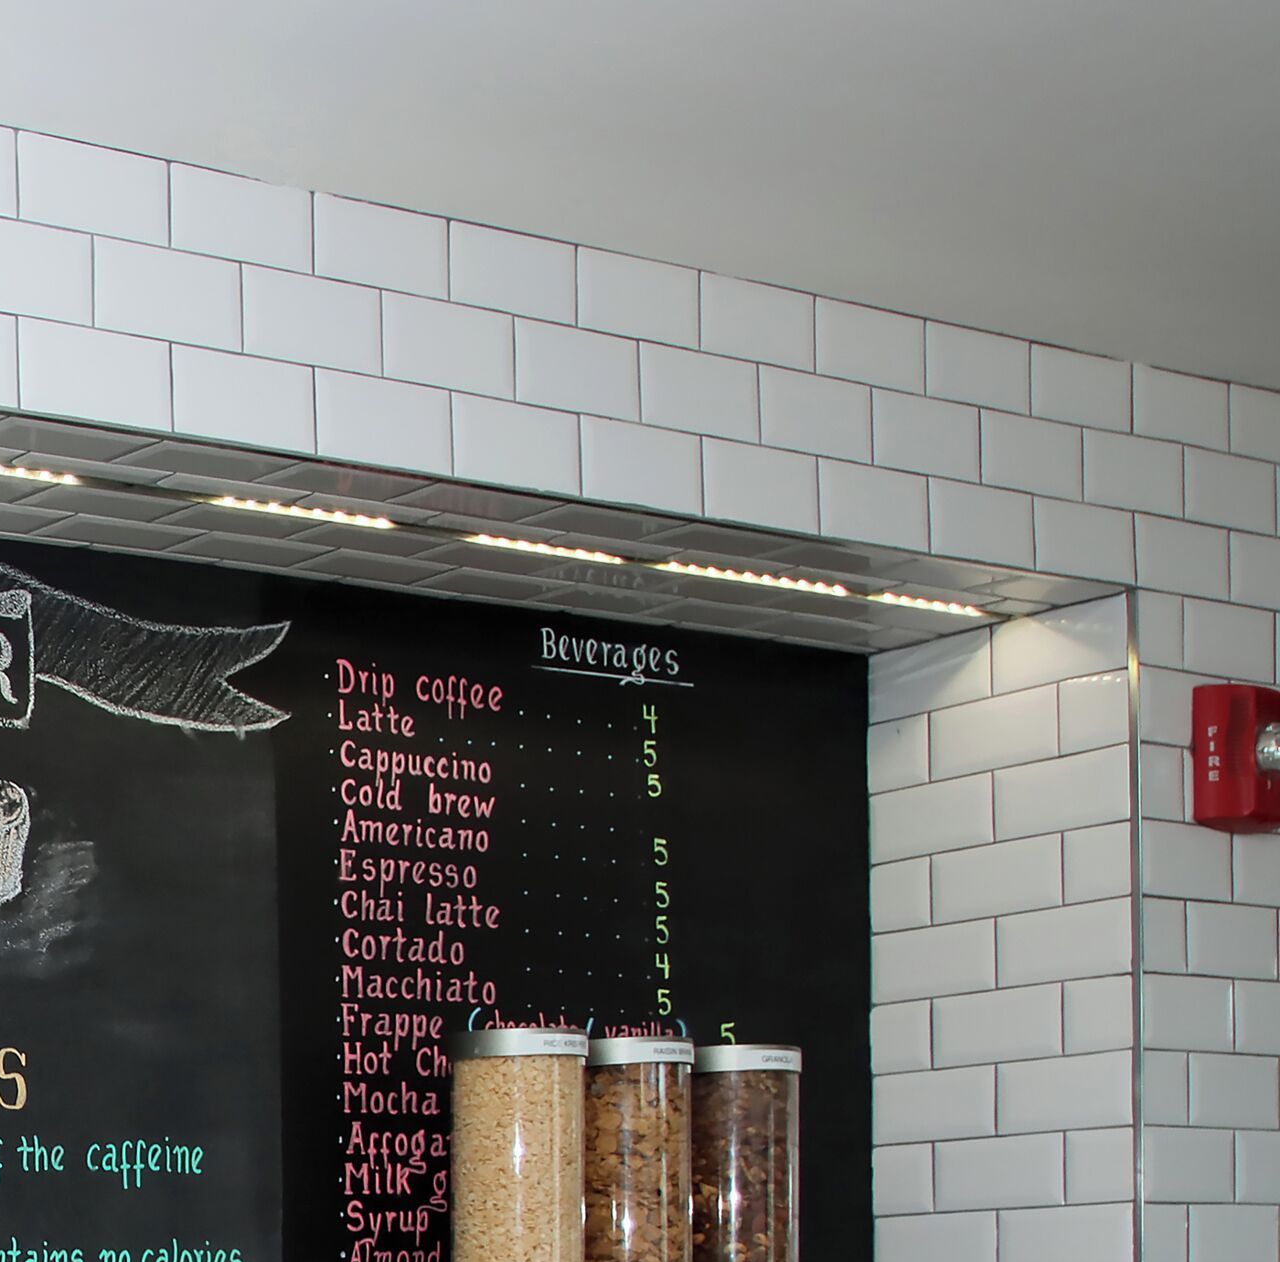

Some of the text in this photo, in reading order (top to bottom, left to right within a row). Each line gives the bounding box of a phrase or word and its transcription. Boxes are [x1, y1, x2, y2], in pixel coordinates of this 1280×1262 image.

[540, 627, 681, 686] Beverages
[336, 658, 658, 735] Drip coffee 4
[338, 700, 658, 768] Latte 5
[1207, 724, 1221, 782] FIRE
[340, 741, 662, 798] Cappuccino 5
[341, 779, 495, 819] Cold brew
[341, 809, 669, 867] Americano 5
[339, 849, 670, 909] Espresso 5
[341, 891, 669, 945] Chai latte 5
[342, 928, 670, 981] Cortado 4
[341, 964, 672, 1017] Macchiato 5
[341, 1003, 443, 1051] Frappe
[342, 1041, 392, 1077] Hot
[343, 1081, 440, 1116] Mocha
[16, 1134, 65, 1172] the
[86, 1136, 204, 1189] caffeine
[344, 1161, 412, 1196] Milk
[346, 1199, 429, 1248] Syrup
